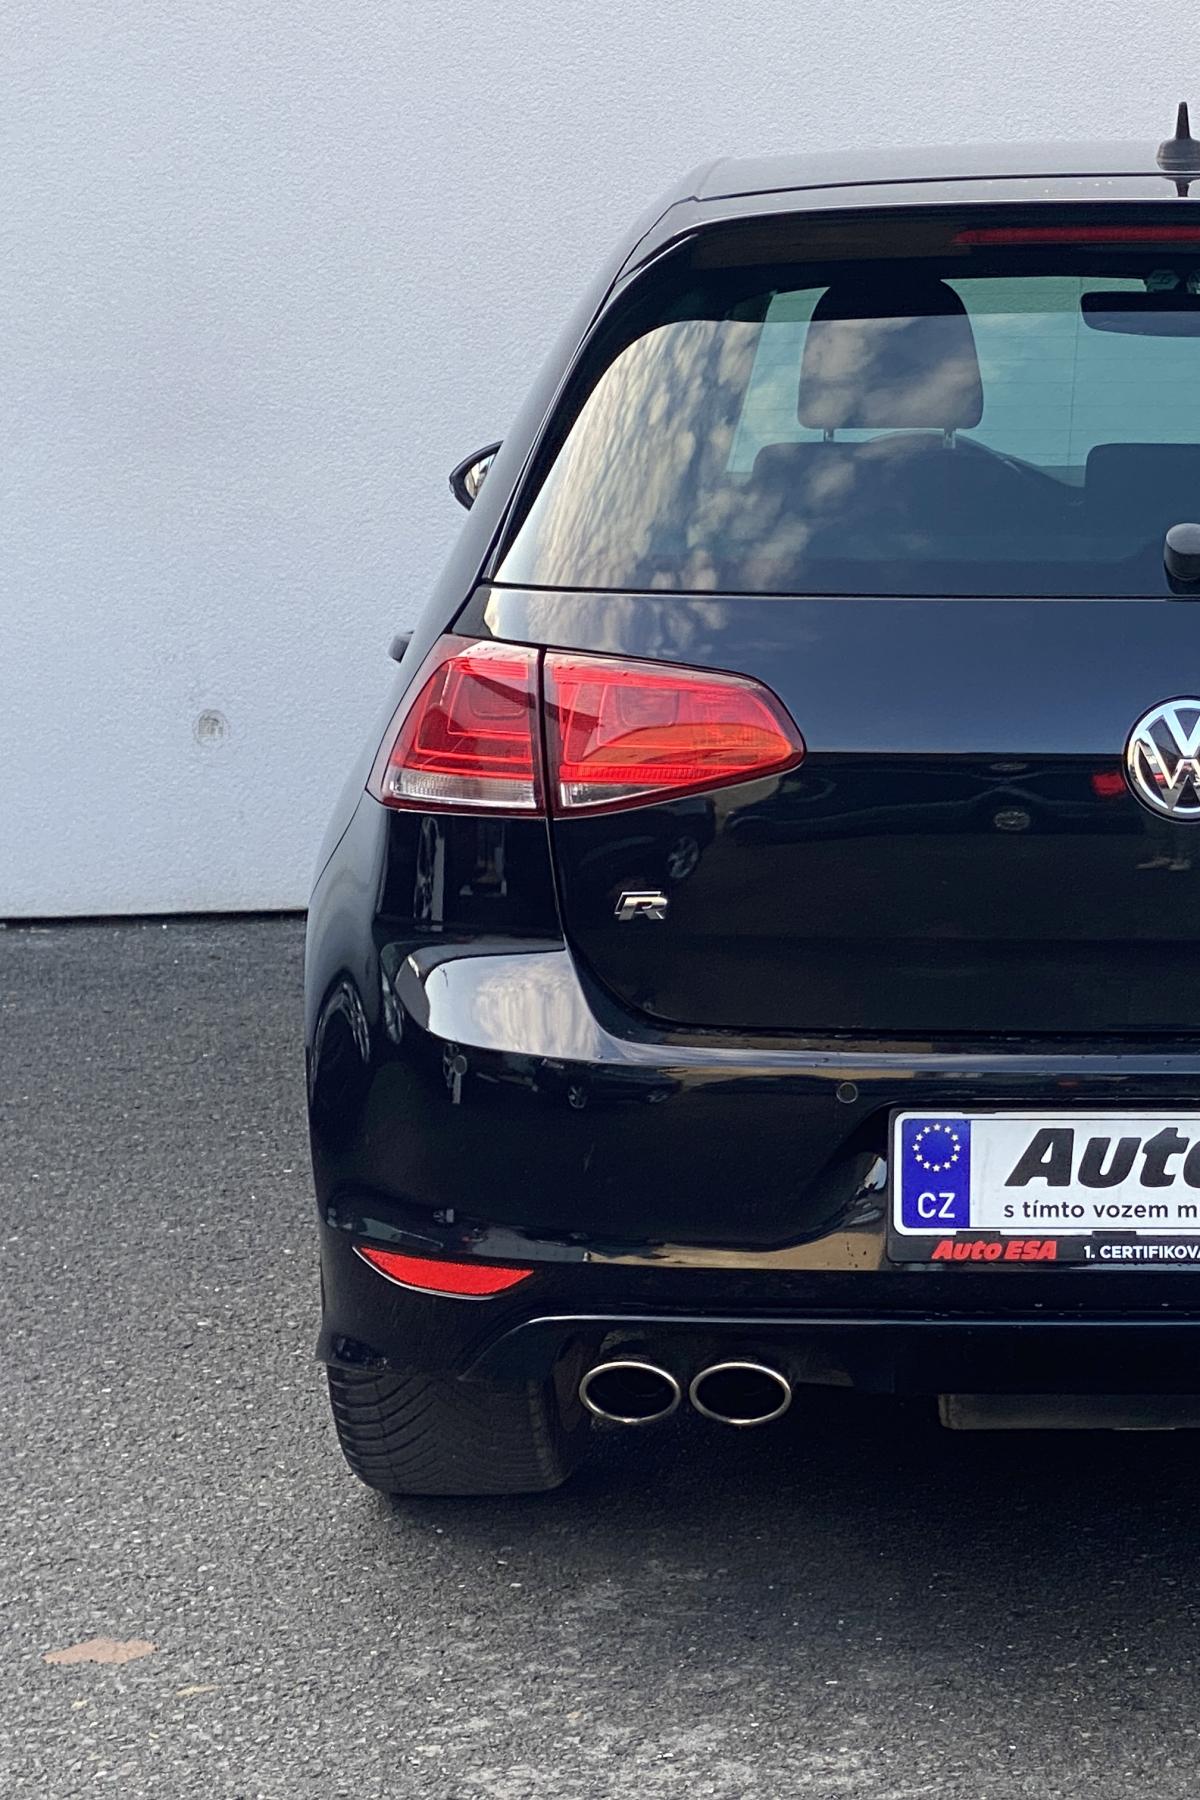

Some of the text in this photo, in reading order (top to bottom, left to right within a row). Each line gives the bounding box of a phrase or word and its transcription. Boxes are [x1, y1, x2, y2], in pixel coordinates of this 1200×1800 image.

[614, 891, 668, 920] R
[917, 1192, 956, 1219] CZ
[1003, 1203, 1014, 1218] s
[1022, 1199, 1085, 1219] tímto
[1092, 1203, 1169, 1219] vozem
[931, 1239, 1057, 1261] Auto ESA
[1083, 1245, 1096, 1259] 1.
